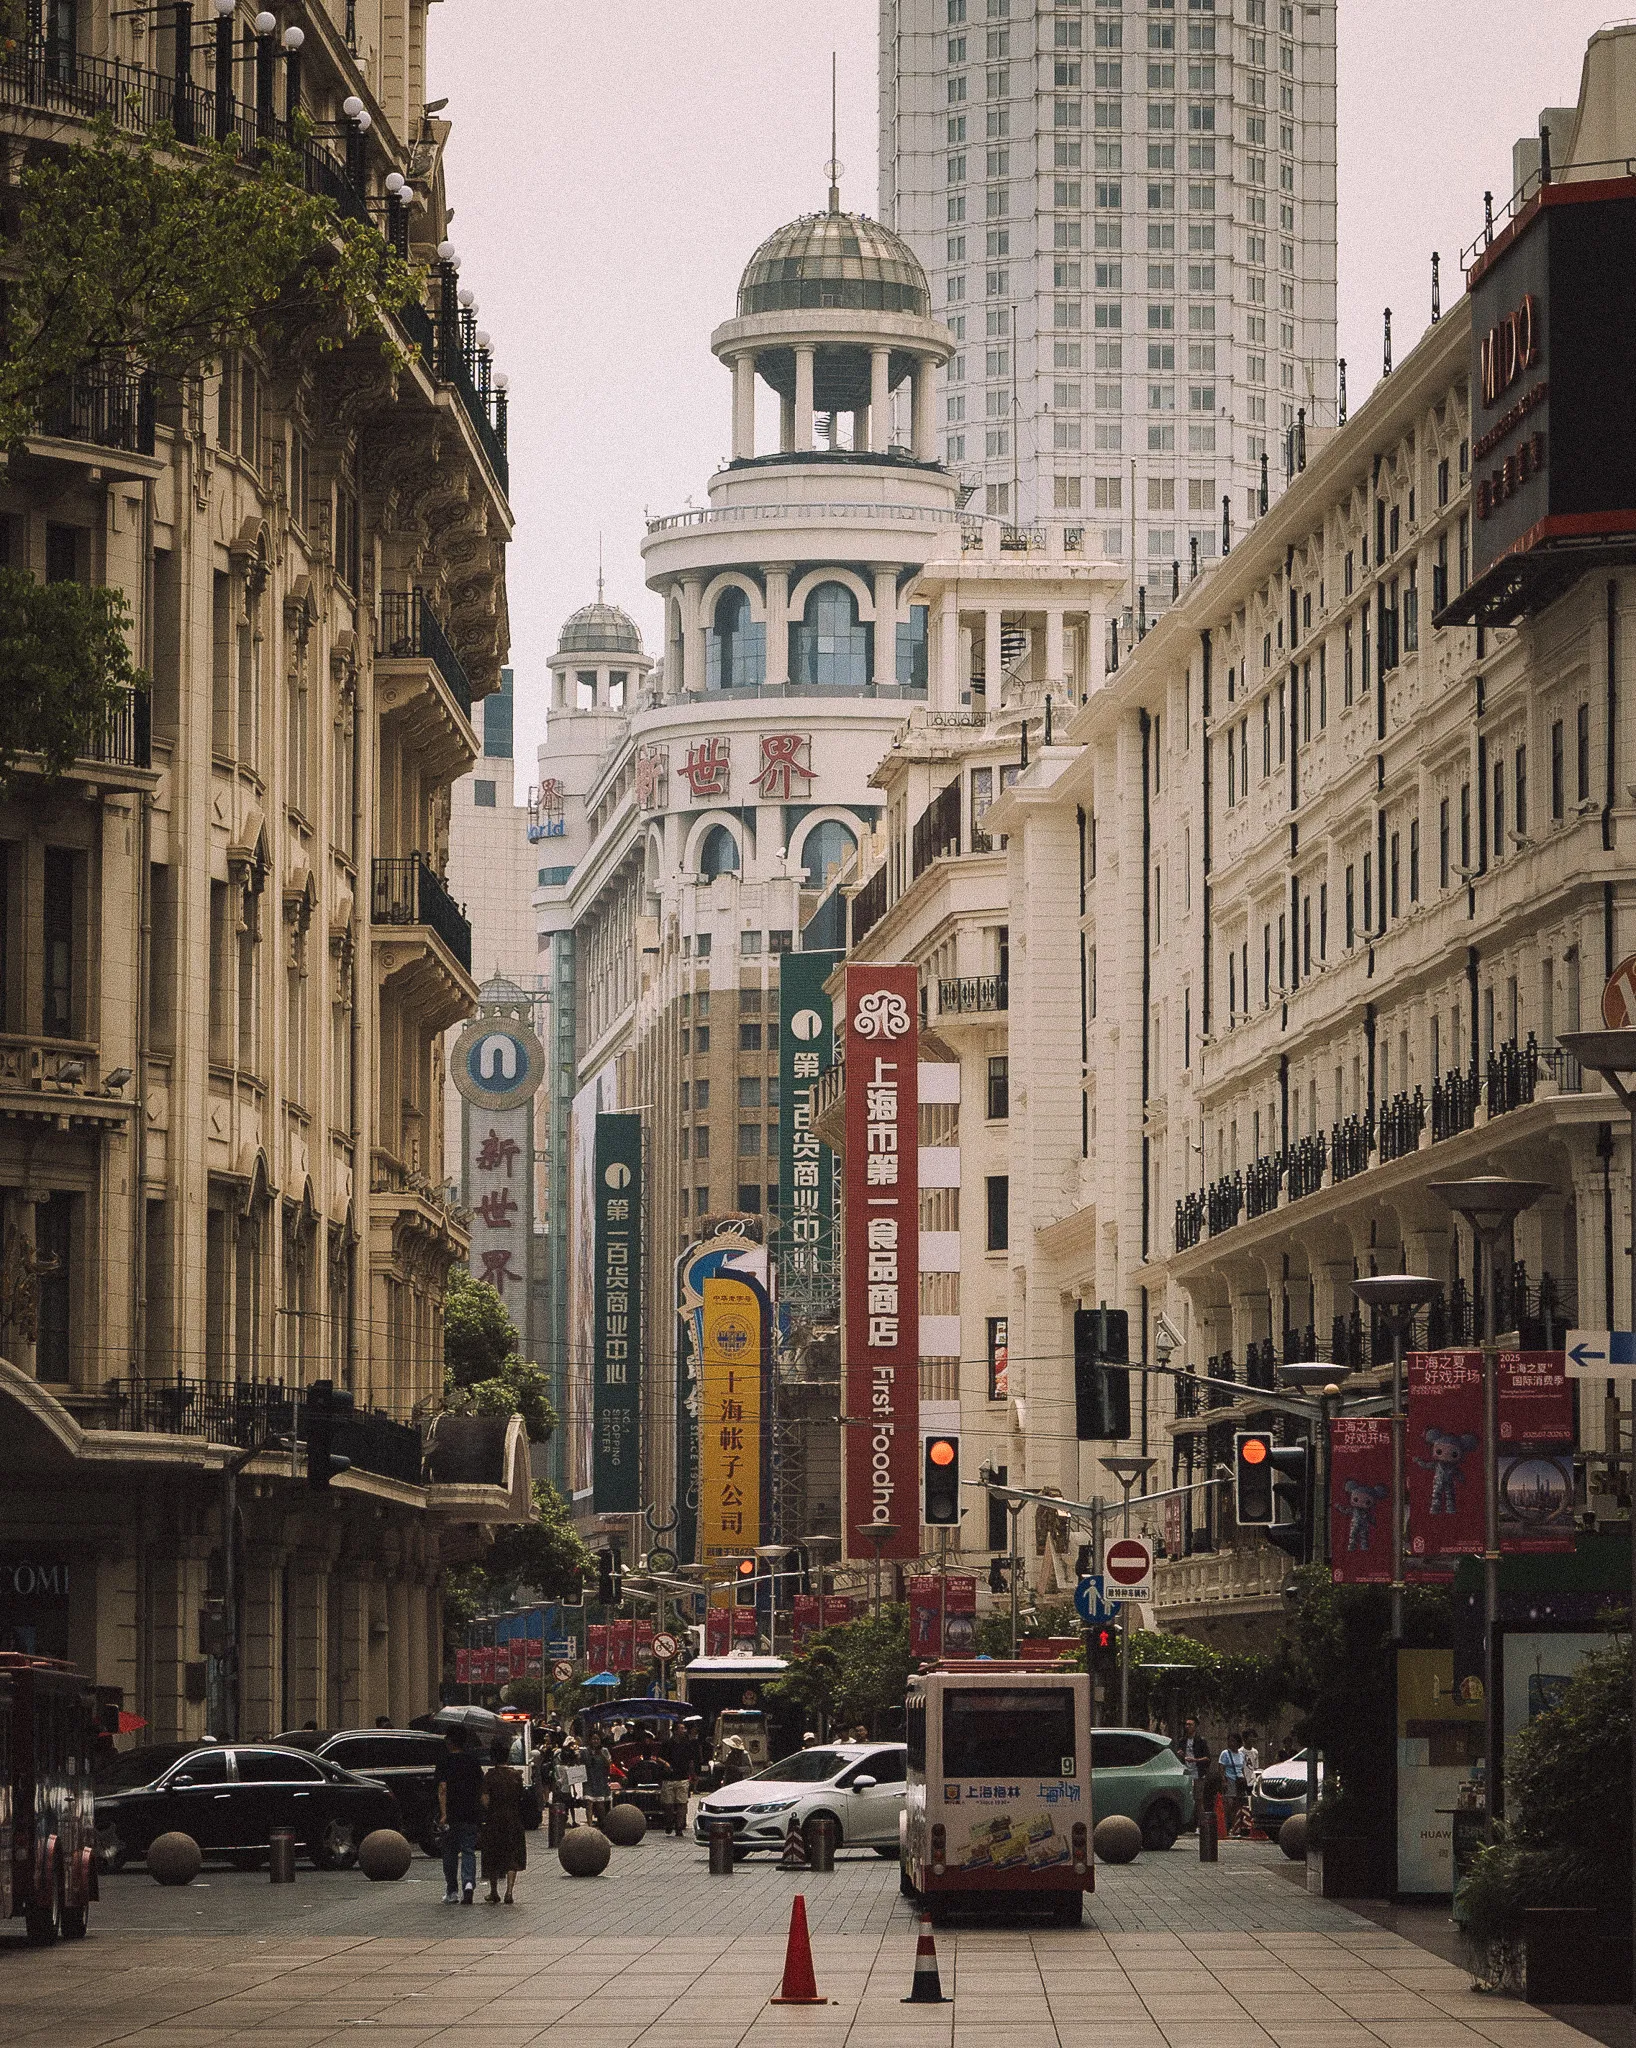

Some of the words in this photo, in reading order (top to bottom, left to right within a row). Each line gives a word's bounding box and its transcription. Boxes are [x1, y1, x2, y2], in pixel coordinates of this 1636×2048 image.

[636, 734, 820, 808] 新世界
[473, 1128, 522, 1294] 新世界
[867, 1056, 899, 1347] 上海市第一食品商店
[605, 1199, 629, 1384] 第一百货商业中心
[1411, 1355, 1466, 1370] 上海之夏
[1424, 1369, 1481, 1384] 好戏开场
[1500, 1354, 1521, 1362] 2025
[872, 1366, 895, 1414] First
[602, 1408, 611, 1453] CENTER
[612, 1408, 621, 1466] SHOPPING
[1333, 1420, 1379, 1433] 上海之夏
[1344, 1433, 1391, 1445] 好戏开场
[720, 1371, 744, 1535] 上海帐子公司
[1063, 1758, 1073, 1774] 9
